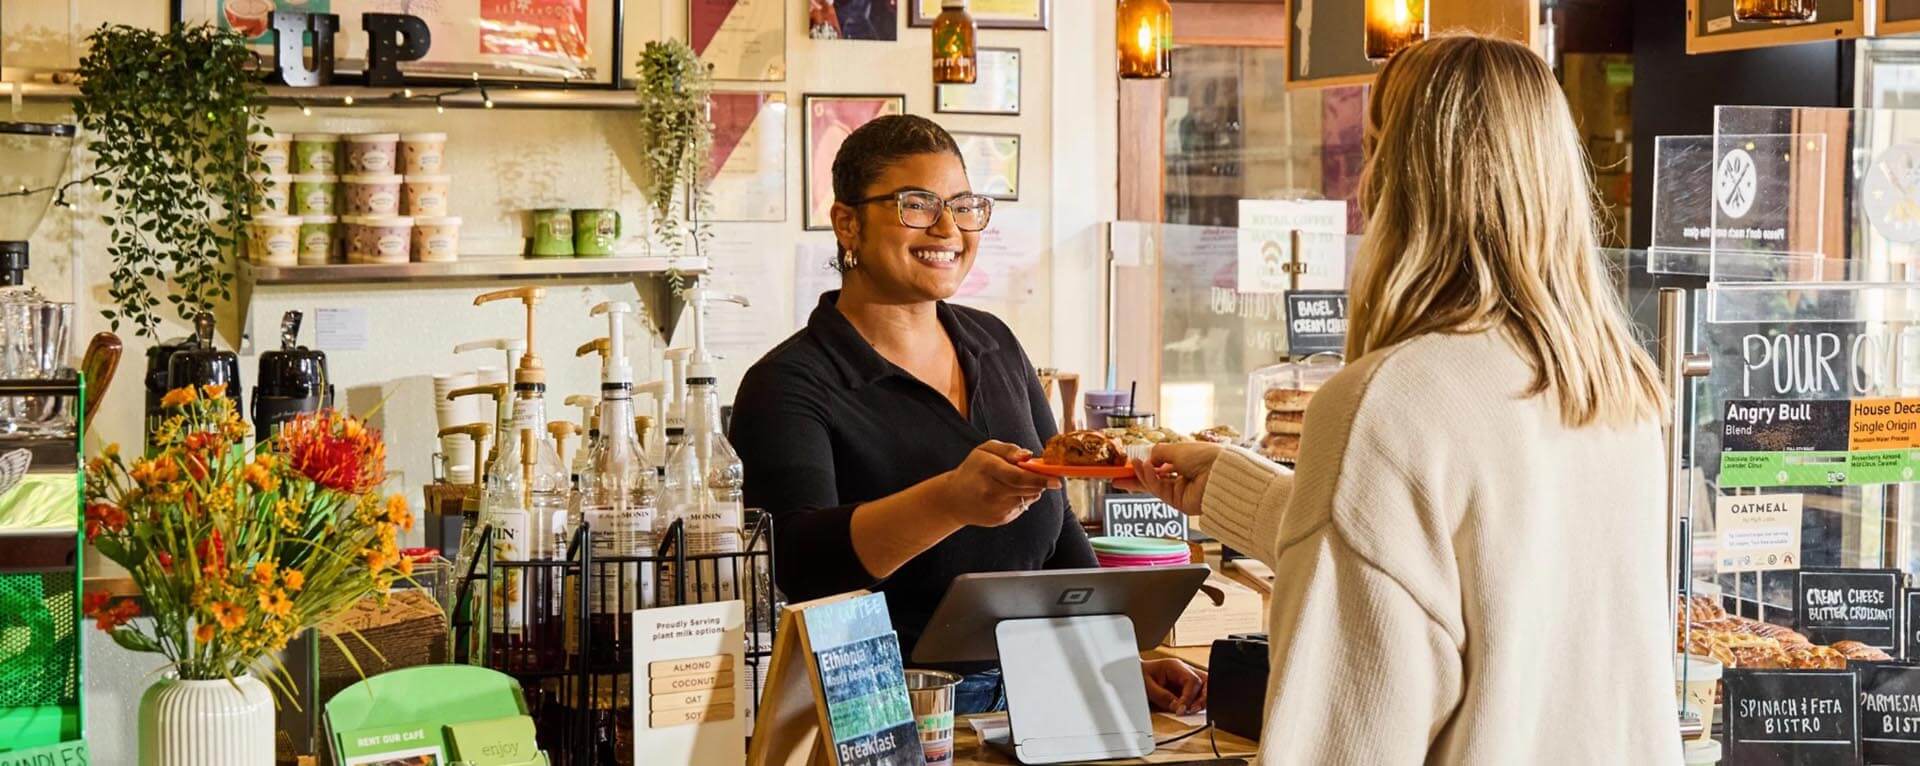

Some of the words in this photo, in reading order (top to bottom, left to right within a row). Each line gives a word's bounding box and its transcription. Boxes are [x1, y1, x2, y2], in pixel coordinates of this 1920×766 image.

[1297, 300, 1334, 317] BAGEL
[1294, 318, 1326, 333] CREAM
[1743, 332, 1840, 397] POUR
[1726, 403, 1775, 424] Angry
[1779, 403, 1811, 420] Bull
[1854, 403, 1891, 417] House
[1725, 424, 1752, 436] Blend
[1854, 420, 1885, 435] Single
[1886, 419, 1917, 433] Origin
[1112, 503, 1179, 520] PUMPKIN
[1731, 503, 1788, 514] OATMEAL
[1114, 522, 1166, 538] BREAD
[1806, 588, 1844, 605] CREAM
[1848, 588, 1885, 604] CHEESE
[1808, 605, 1848, 621] BUTTER
[1849, 606, 1893, 621] CROISSANT
[656, 620, 688, 631] Proudly
[690, 617, 721, 628] Serving
[652, 631, 674, 641] plant
[676, 630, 693, 638] milk
[673, 661, 711, 672] ALMOND
[672, 676, 715, 688] COCONUT
[685, 695, 702, 705] OAT
[1740, 698, 1797, 718] SPINACH
[1810, 698, 1843, 715] FETA
[1861, 691, 1920, 713] PARMESA
[685, 711, 703, 720] SOY
[1765, 717, 1820, 734] BISTRO
[357, 735, 380, 747] RENT
[382, 733, 401, 745] OUR
[839, 732, 898, 763] Breakfast
[481, 740, 520, 758] enjoy
